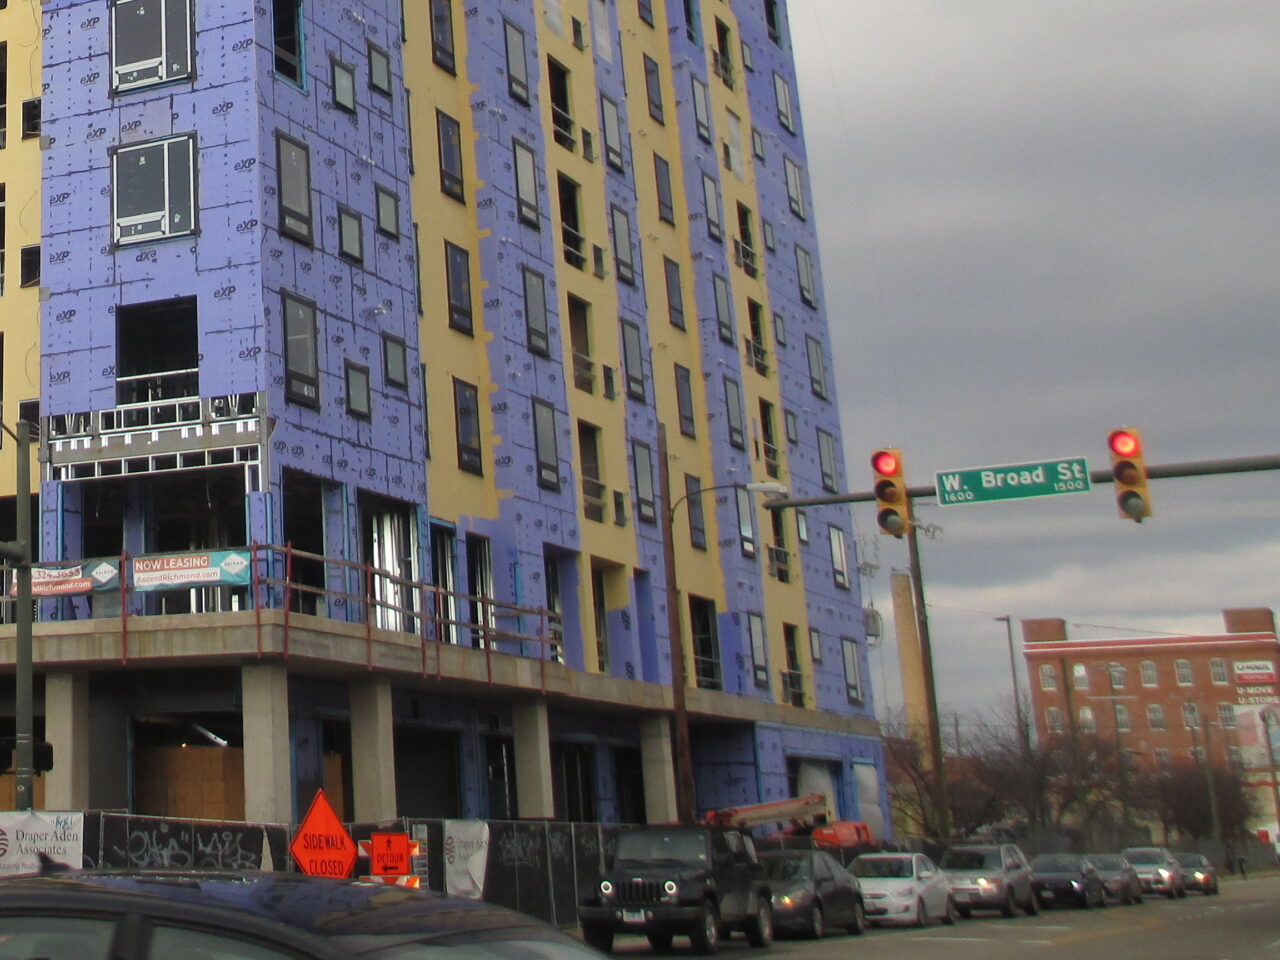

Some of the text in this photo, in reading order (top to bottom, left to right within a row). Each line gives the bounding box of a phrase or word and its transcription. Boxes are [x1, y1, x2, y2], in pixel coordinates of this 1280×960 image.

[81, 17, 100, 29] eXP
[232, 39, 253, 51] eXP
[80, 73, 99, 84] eXP
[212, 102, 233, 114] eXP
[121, 120, 141, 133] eXP
[87, 128, 106, 140] eXP
[234, 158, 256, 171] eXP
[50, 193, 70, 204] eXP
[236, 220, 258, 232] eXP
[50, 251, 69, 262] eXP
[214, 286, 235, 298] eXP
[56, 310, 76, 321] eXP
[239, 347, 260, 358] eXP
[50, 371, 70, 382] eXP
[942, 462, 1084, 491] W. Broad St
[1054, 481, 1084, 491] 1500
[945, 492, 974, 502] 1600
[136, 557, 208, 571] NOW LEASING
[136, 572, 218, 583] AscendRichmond.com
[16, 830, 78, 843] Draper Aden
[302, 834, 346, 851] SIDEWALK
[16, 844, 67, 855] Associates
[376, 853, 404, 864] DETOUR
[310, 860, 344, 876] CLOSED
